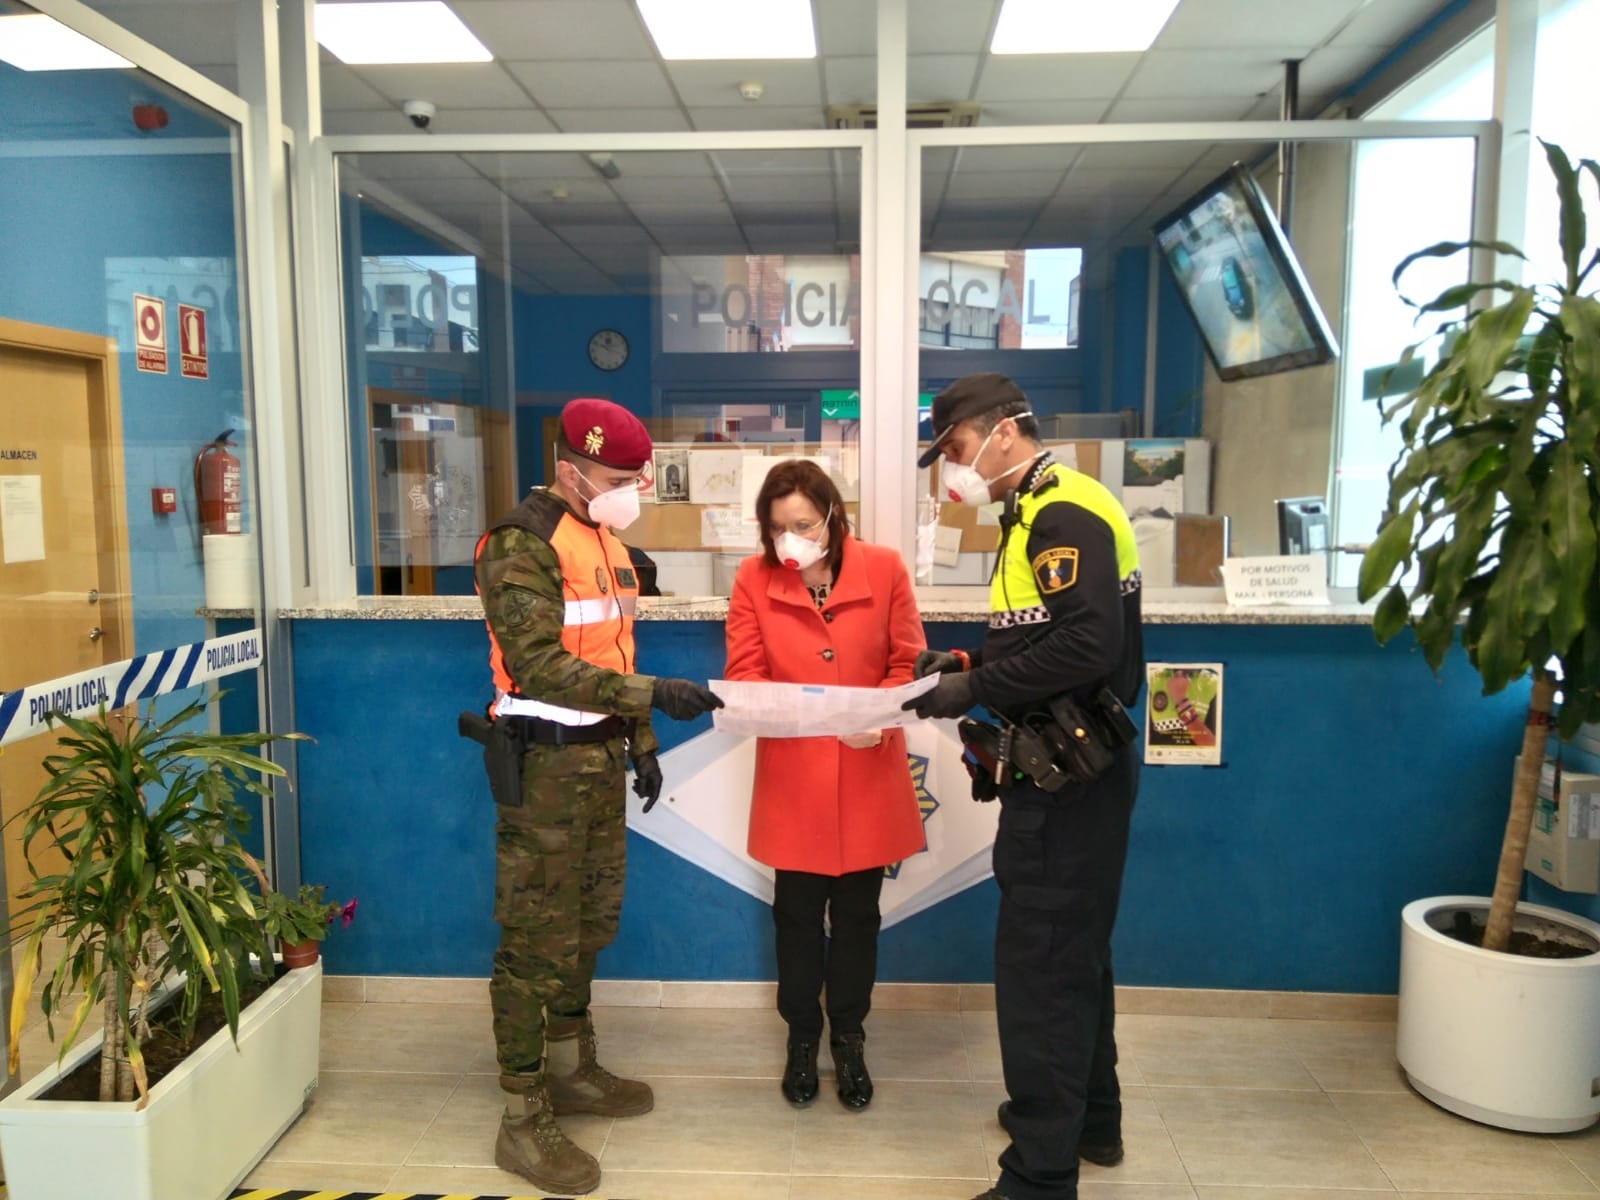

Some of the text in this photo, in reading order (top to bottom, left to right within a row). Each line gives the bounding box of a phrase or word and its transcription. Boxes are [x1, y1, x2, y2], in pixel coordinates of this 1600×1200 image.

[919, 279, 1051, 327] OCAL
[0, 449, 37, 460] ALMACEN
[1240, 563, 1311, 575] POR MOTIVOS
[1250, 577, 1298, 587] DE SALUD
[1268, 589, 1314, 599] PERSONA
[207, 637, 260, 673] POLICIA LOCAL
[29, 676, 110, 727] POLICIA LOCAL
